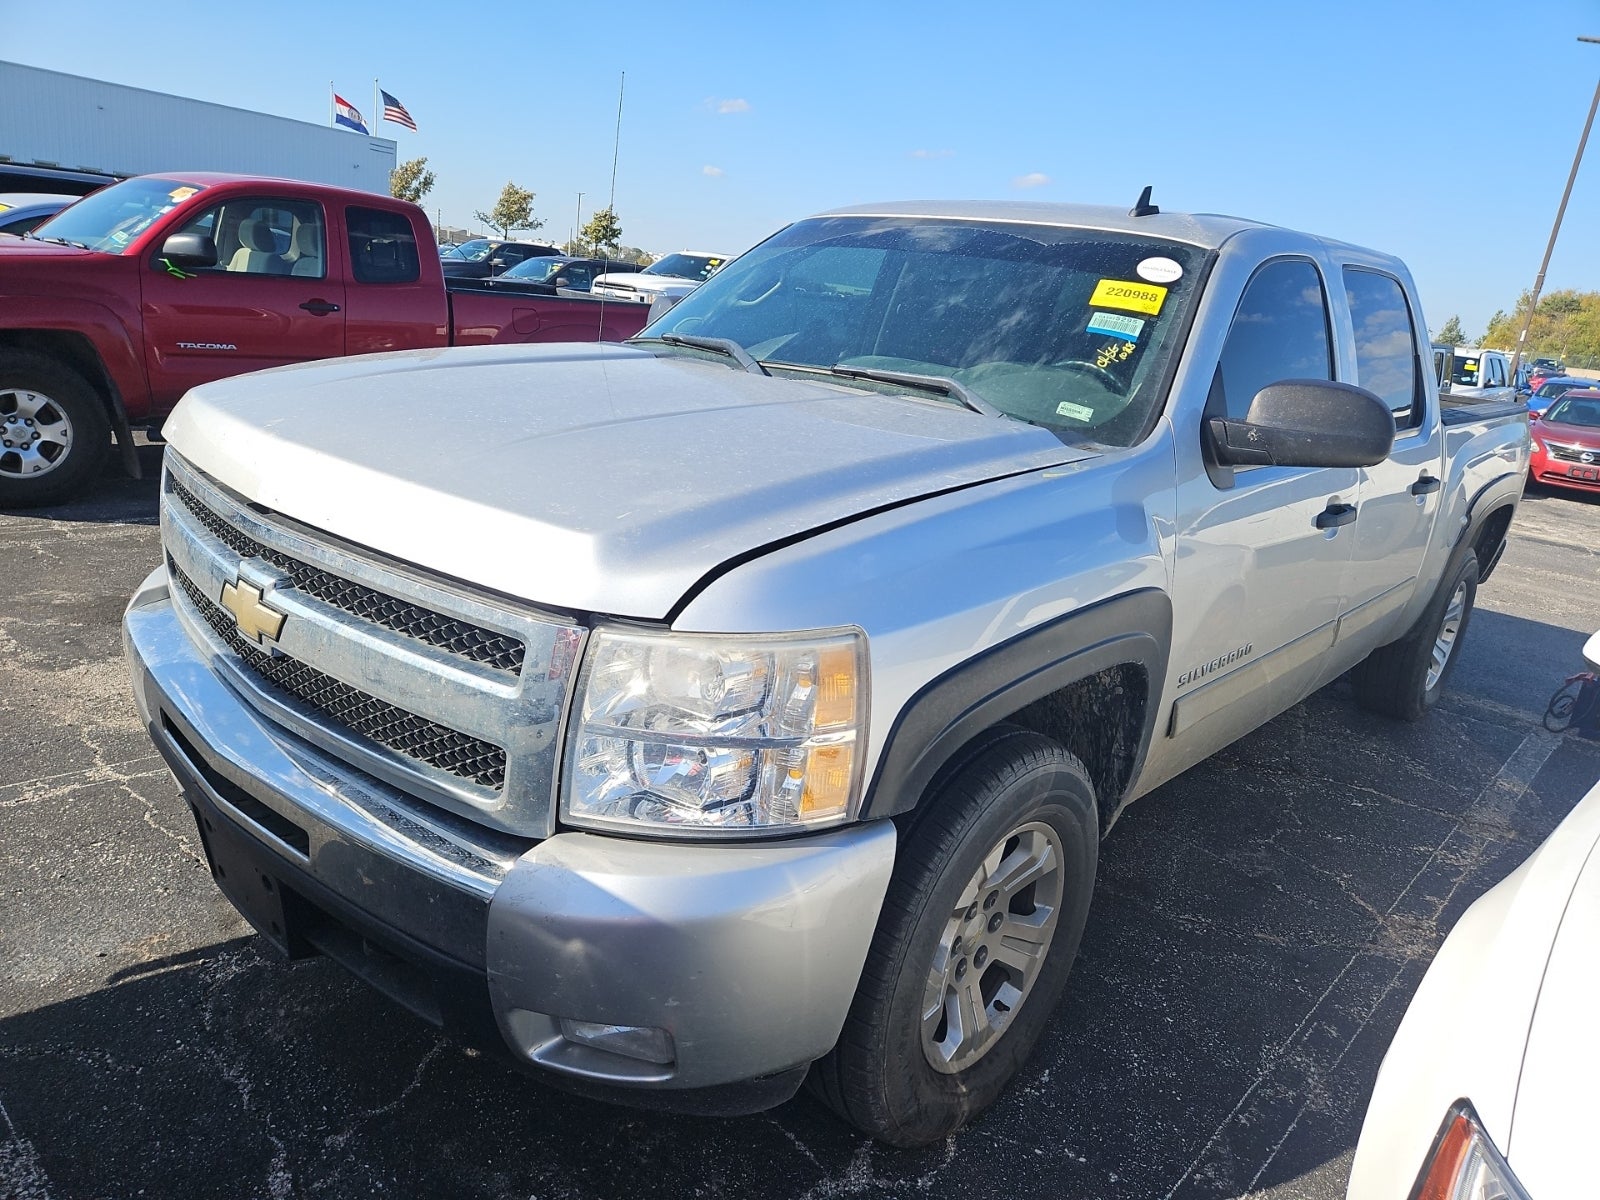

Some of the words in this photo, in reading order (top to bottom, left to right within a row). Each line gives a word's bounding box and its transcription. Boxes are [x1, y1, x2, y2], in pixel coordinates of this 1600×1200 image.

[1105, 286, 1158, 302] 220988
[176, 342, 237, 350] TACOMA
[1177, 642, 1253, 689] SILVERADO
